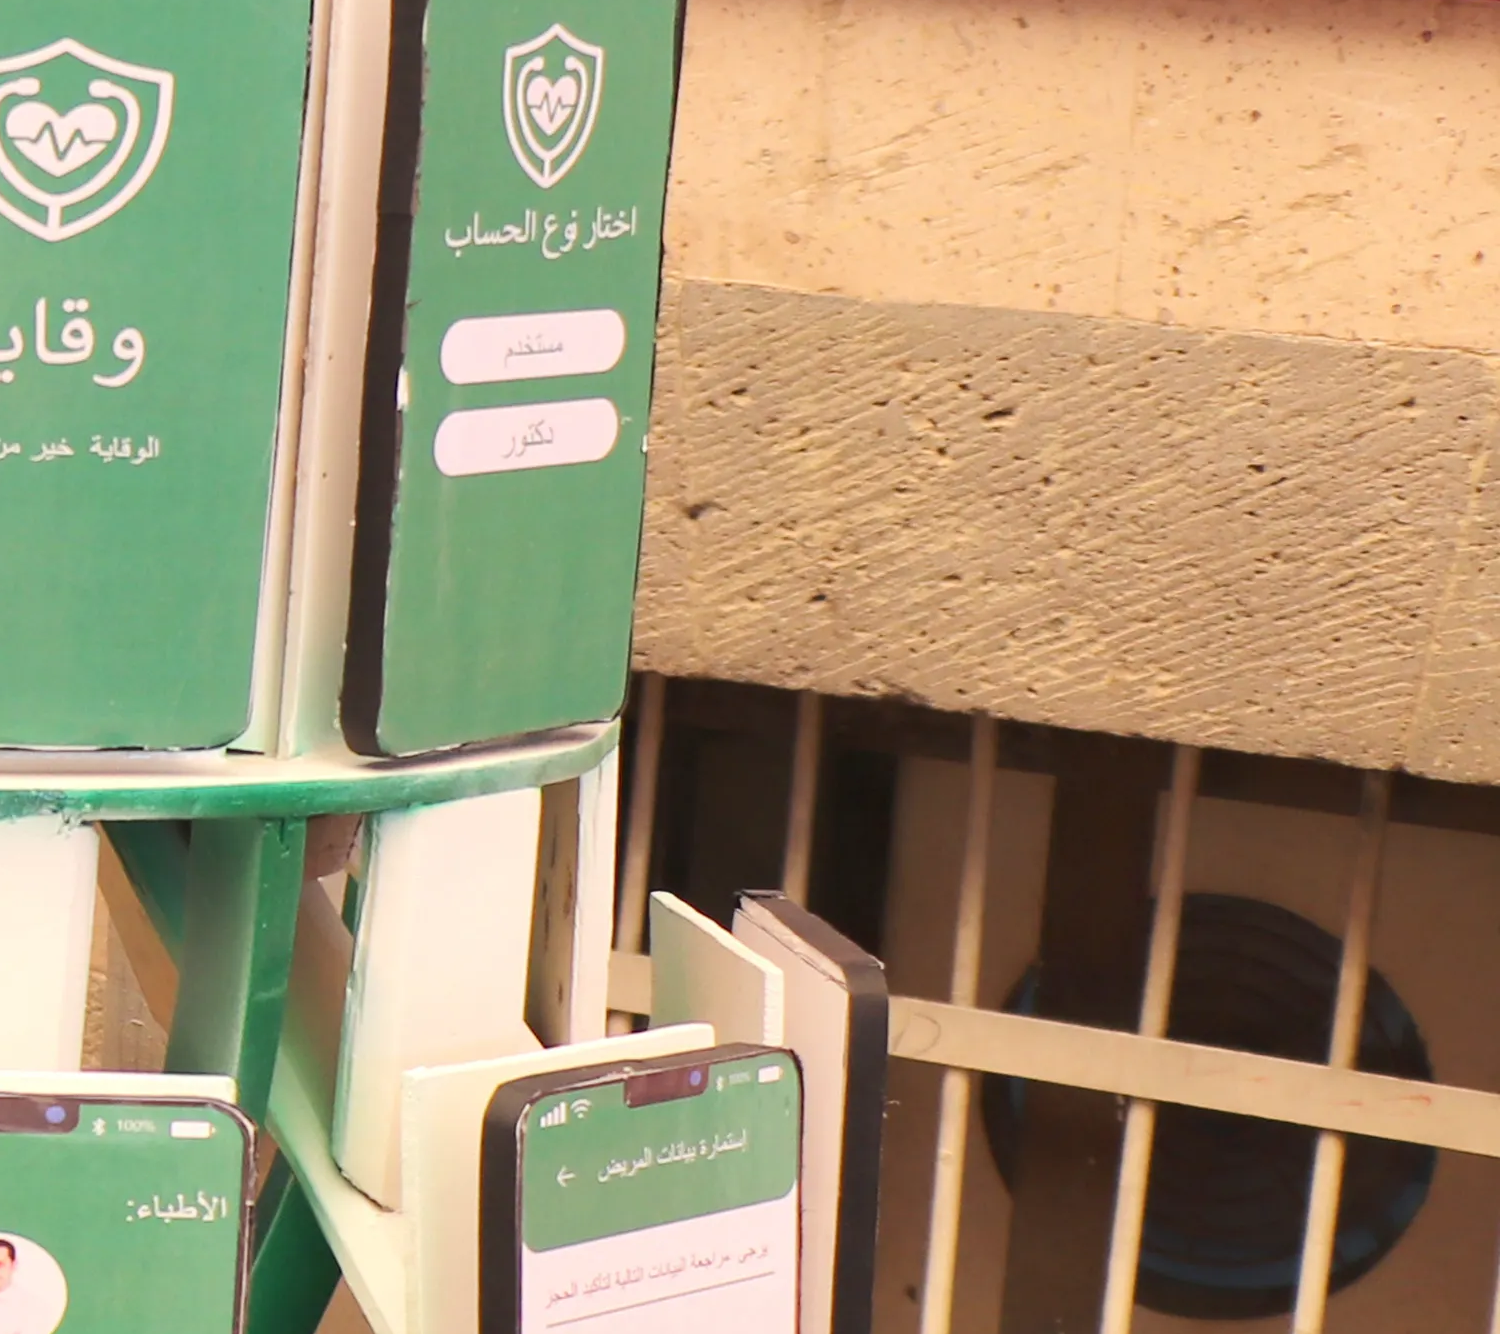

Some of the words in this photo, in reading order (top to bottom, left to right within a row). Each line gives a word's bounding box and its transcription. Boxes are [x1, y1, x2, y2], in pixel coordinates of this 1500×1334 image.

[444, 207, 537, 258] الحساب
[541, 207, 579, 260] نوع
[584, 205, 638, 252] اختار
[30, 435, 75, 464] خير
[89, 433, 162, 466] الوقاية
[501, 419, 555, 459] دكتور
[115, 1118, 156, 1135] 100%
[597, 1148, 654, 1183] المريض
[656, 1142, 697, 1167] بيانات
[125, 1189, 228, 1225] الأطباء:
